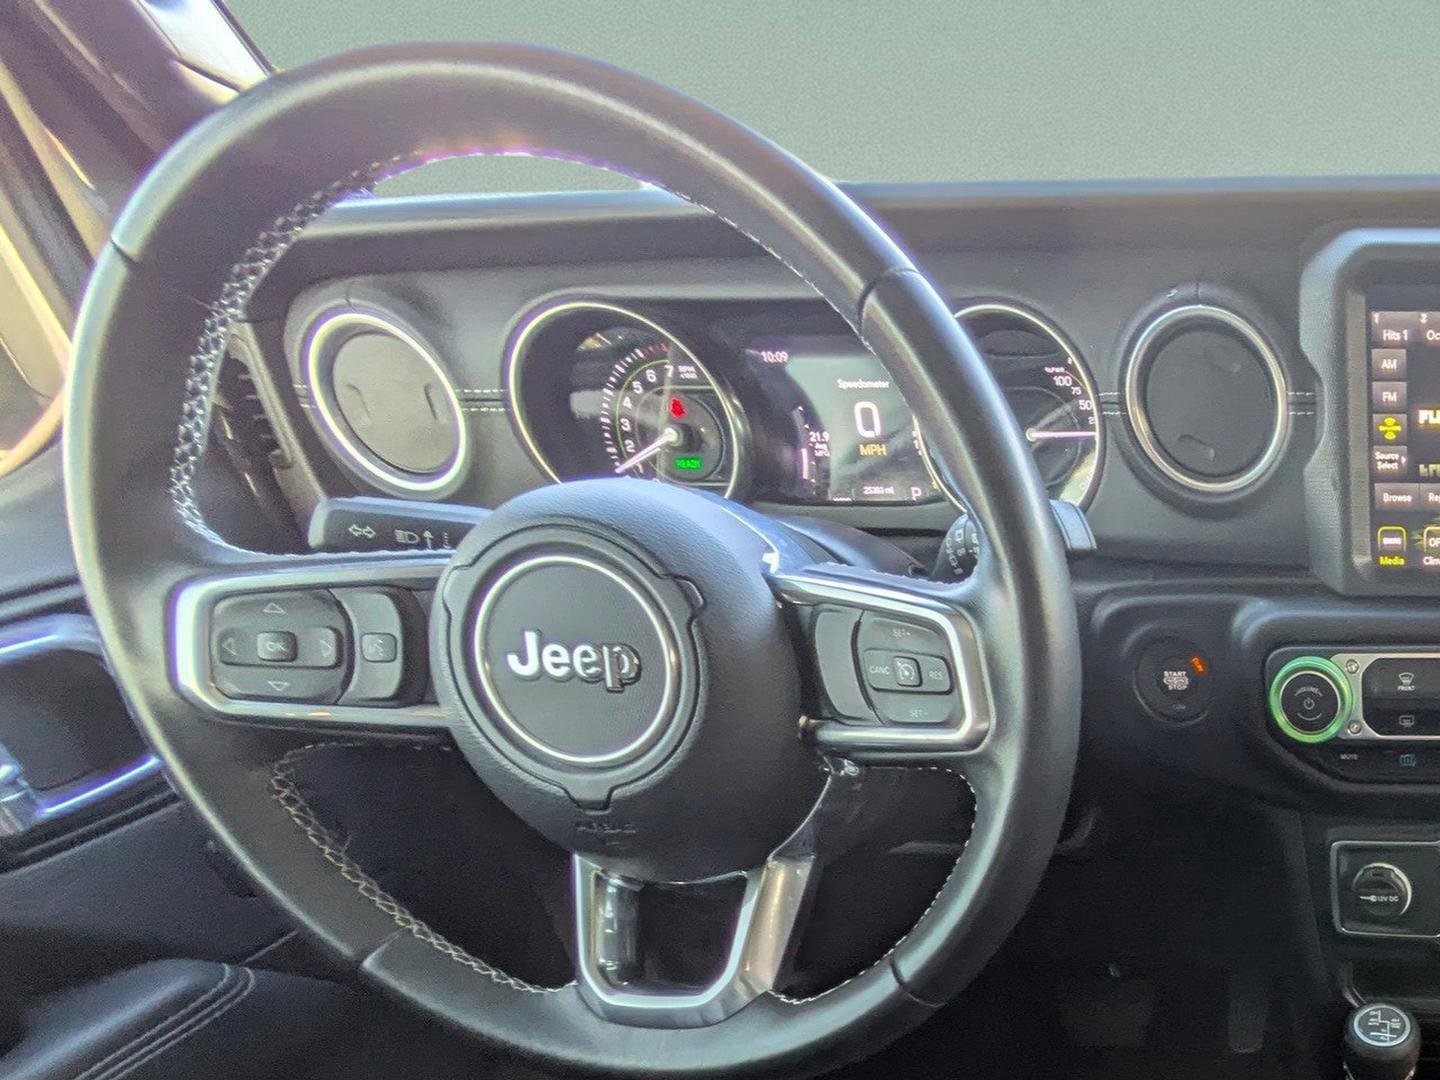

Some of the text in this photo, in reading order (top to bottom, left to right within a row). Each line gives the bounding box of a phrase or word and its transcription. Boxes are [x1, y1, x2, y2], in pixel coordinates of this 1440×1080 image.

[1382, 330, 1401, 341] Hits
[760, 351, 789, 363] 10:09
[1381, 359, 1398, 370] AM
[645, 369, 657, 383] 6
[664, 364, 674, 378] 7
[1053, 376, 1072, 386] 100
[631, 381, 644, 394] 5
[1071, 386, 1082, 396] 75
[1382, 391, 1398, 402] FM
[622, 397, 633, 409] 4
[1079, 400, 1092, 410] 50
[620, 418, 631, 432] 3
[854, 401, 881, 438] 0
[809, 431, 830, 442] 21.9
[624, 440, 636, 453] 2
[859, 444, 887, 456] MPH
[911, 486, 922, 501] P
[1383, 493, 1412, 503] Browse
[507, 628, 642, 693] Jeep
